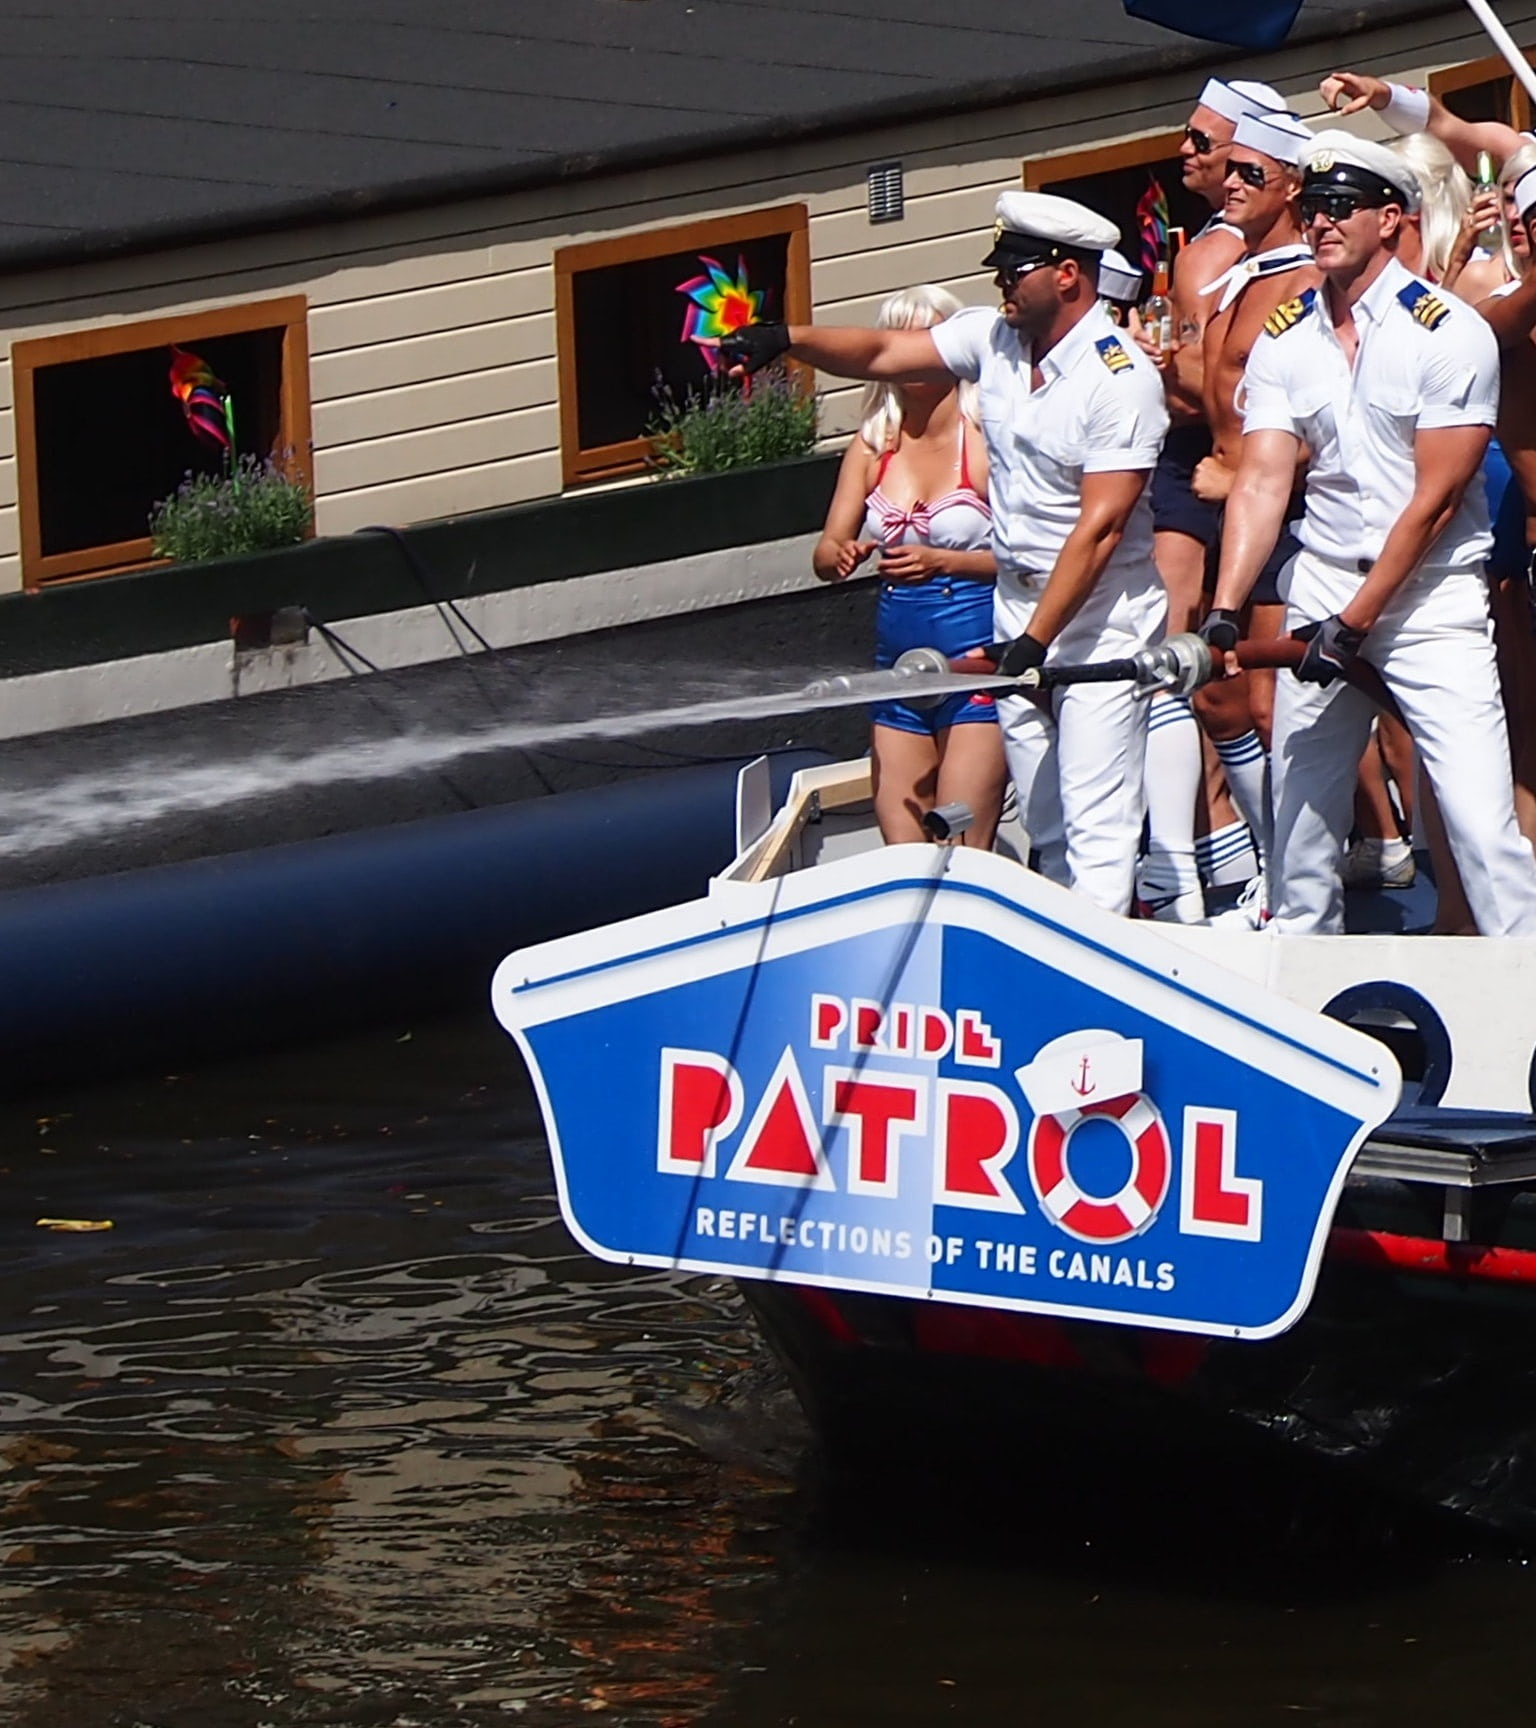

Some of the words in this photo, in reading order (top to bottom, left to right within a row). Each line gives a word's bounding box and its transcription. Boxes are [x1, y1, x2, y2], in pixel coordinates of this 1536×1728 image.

[810, 993, 1001, 1068] PRIDE
[657, 1043, 1264, 1244] PATROL
[696, 1208, 912, 1259] REFLECTIONS
[926, 1235, 964, 1264] OF
[975, 1241, 1037, 1274] THE
[1048, 1250, 1176, 1292] CANALS
